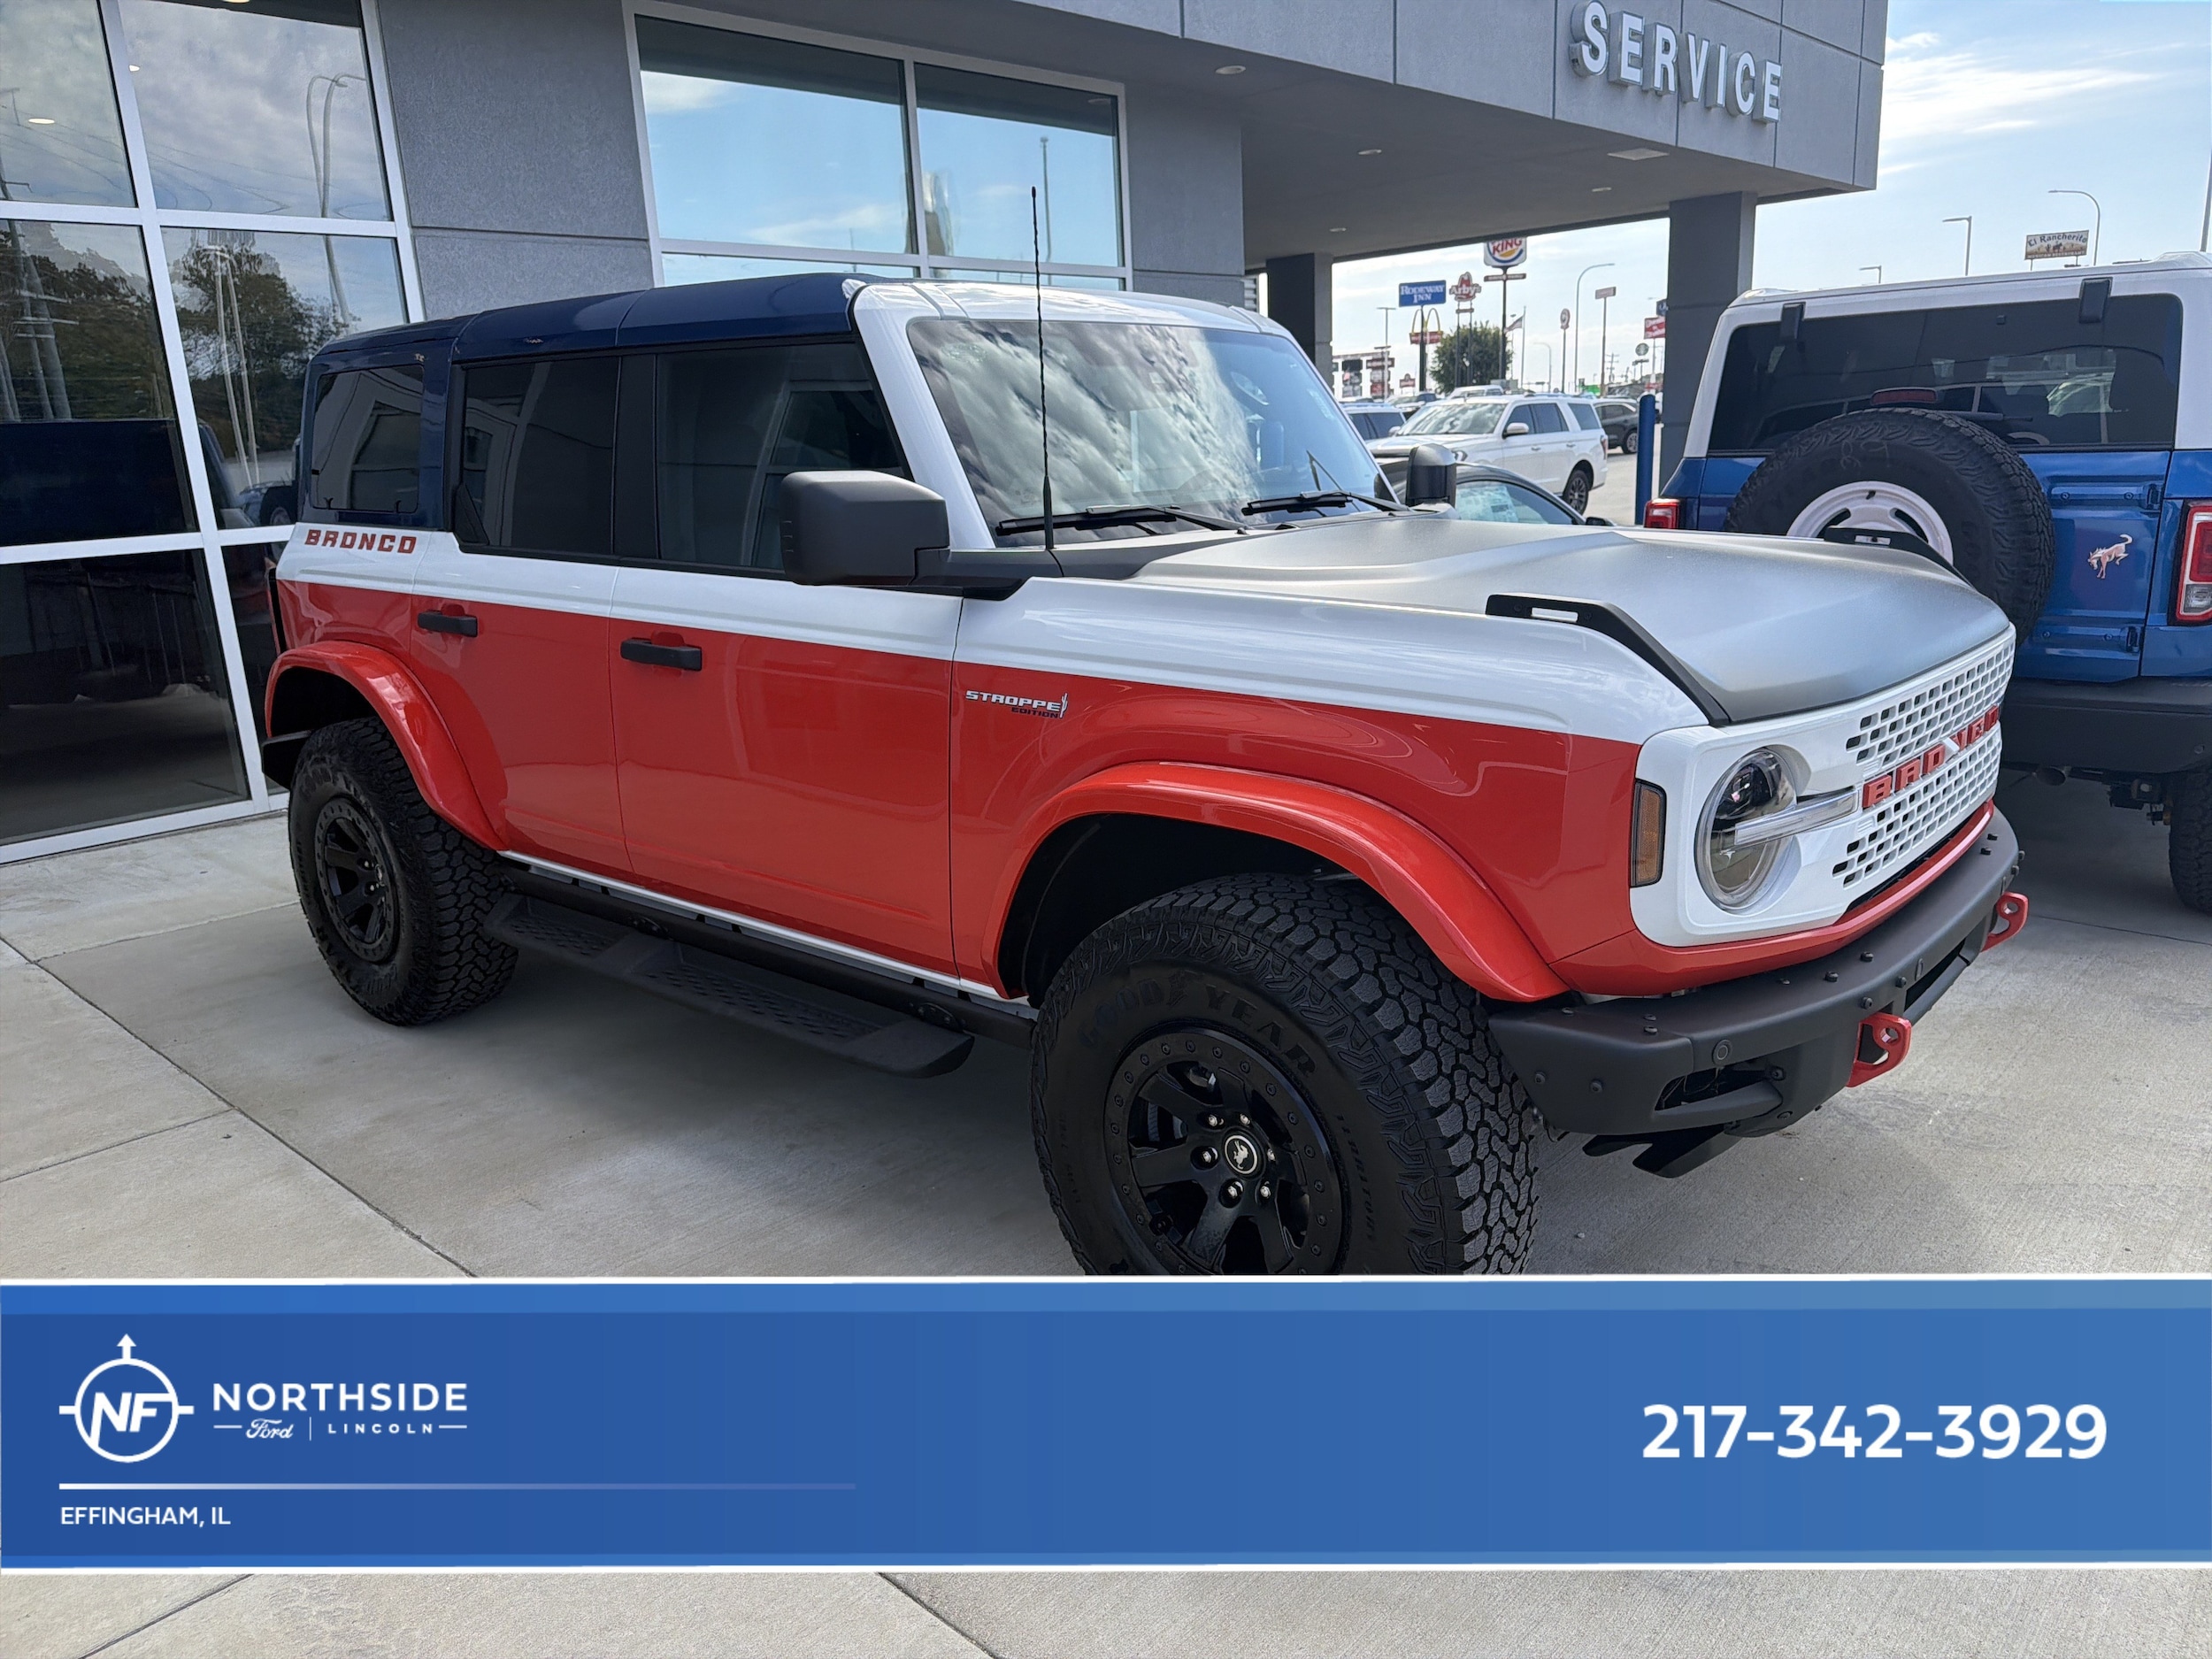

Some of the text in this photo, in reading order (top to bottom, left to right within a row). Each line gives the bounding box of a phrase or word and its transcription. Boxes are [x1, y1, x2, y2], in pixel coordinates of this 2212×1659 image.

[1571, 1, 1782, 123] SERVICE
[2028, 234, 2087, 247] El Rancherito
[1493, 239, 1522, 256] KING
[1401, 285, 1445, 296] RODEWAY
[1450, 285, 1481, 296] Arby's
[1413, 294, 1432, 303] INN
[304, 529, 417, 554] BRONCO
[965, 690, 1061, 711] STROPPE
[1011, 707, 1058, 718] EDITION
